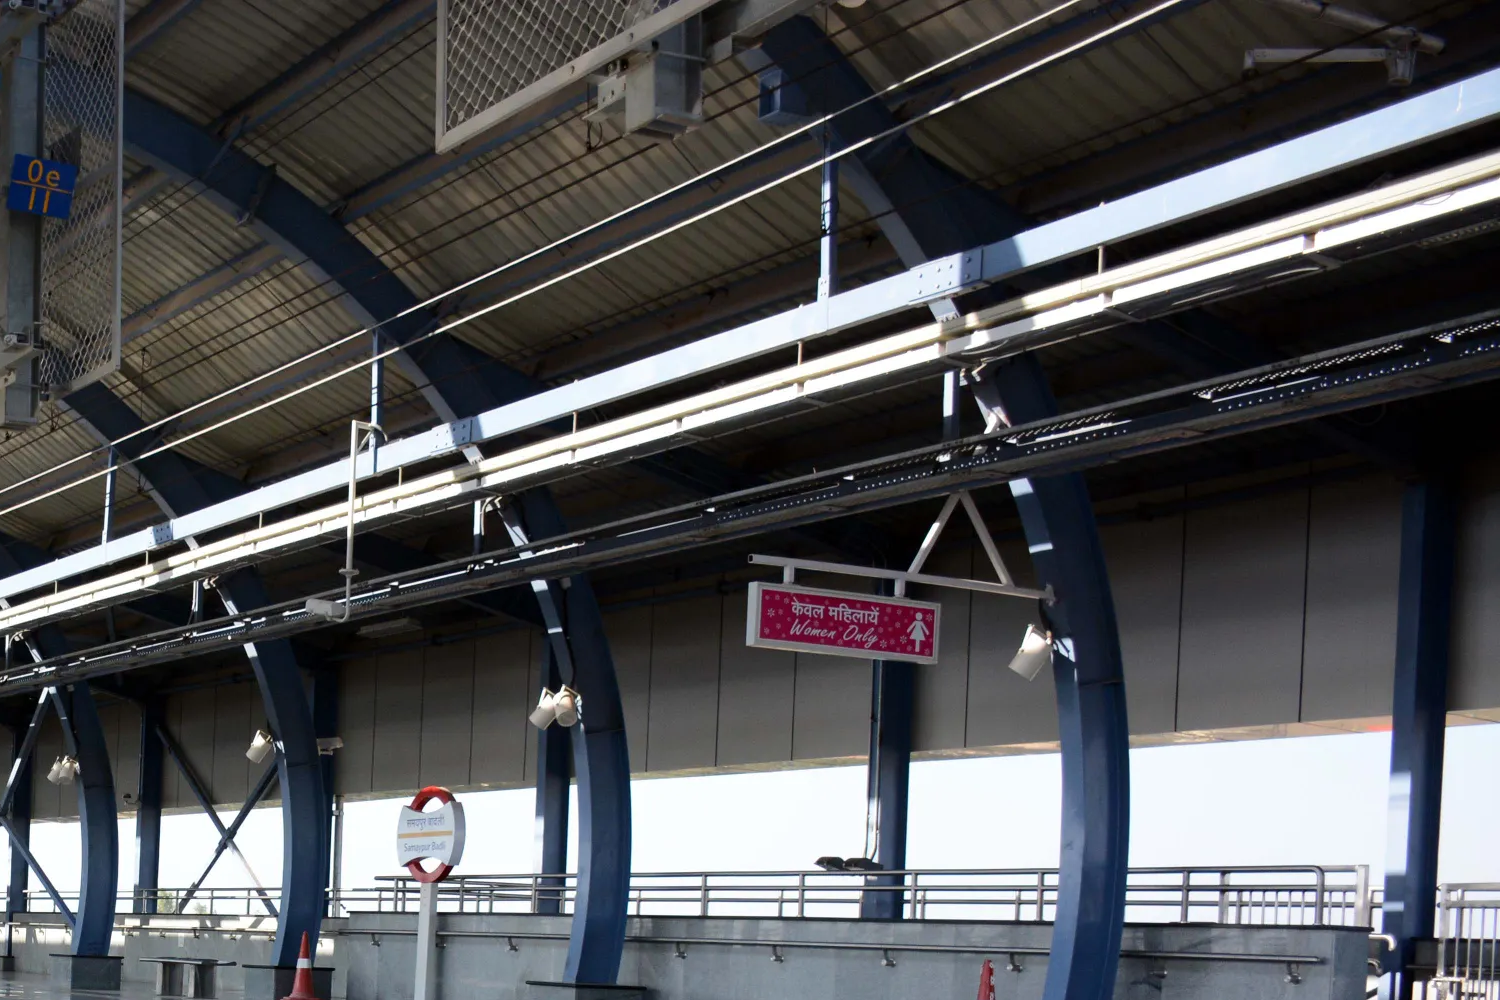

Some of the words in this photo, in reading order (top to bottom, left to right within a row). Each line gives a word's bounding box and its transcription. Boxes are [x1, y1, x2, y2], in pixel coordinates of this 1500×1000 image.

[790, 596, 826, 620] केवल
[828, 603, 880, 625] महिलायें
[789, 618, 837, 640] Women
[843, 624, 879, 648] Only
[403, 843, 431, 854] Samaypur
